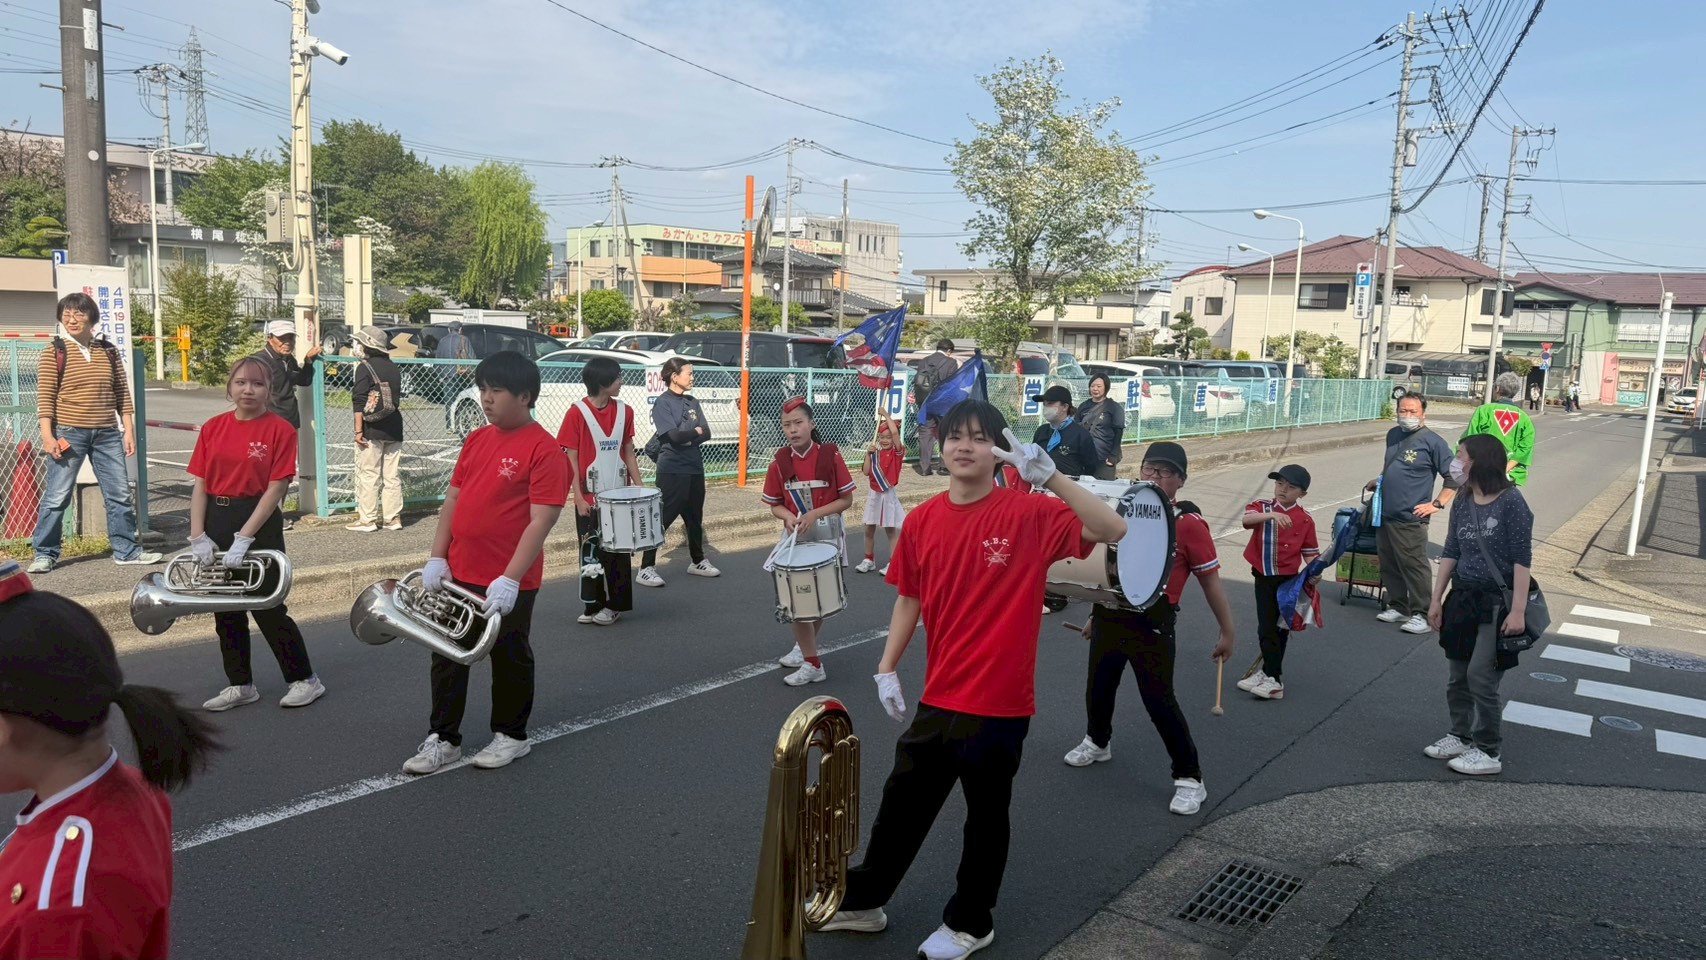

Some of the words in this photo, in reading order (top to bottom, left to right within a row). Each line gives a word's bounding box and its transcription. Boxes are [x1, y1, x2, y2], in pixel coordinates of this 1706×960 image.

[1358, 274, 1367, 285] P
[1024, 378, 1042, 414] 営
[1126, 379, 1140, 410] 駐
[1195, 383, 1208, 410] 車
[599, 439, 619, 447] YAMAHA
[1134, 503, 1162, 520] YAMAHA
[638, 515, 647, 540] YAMAHA
[982, 537, 1010, 548] H.B.C.
